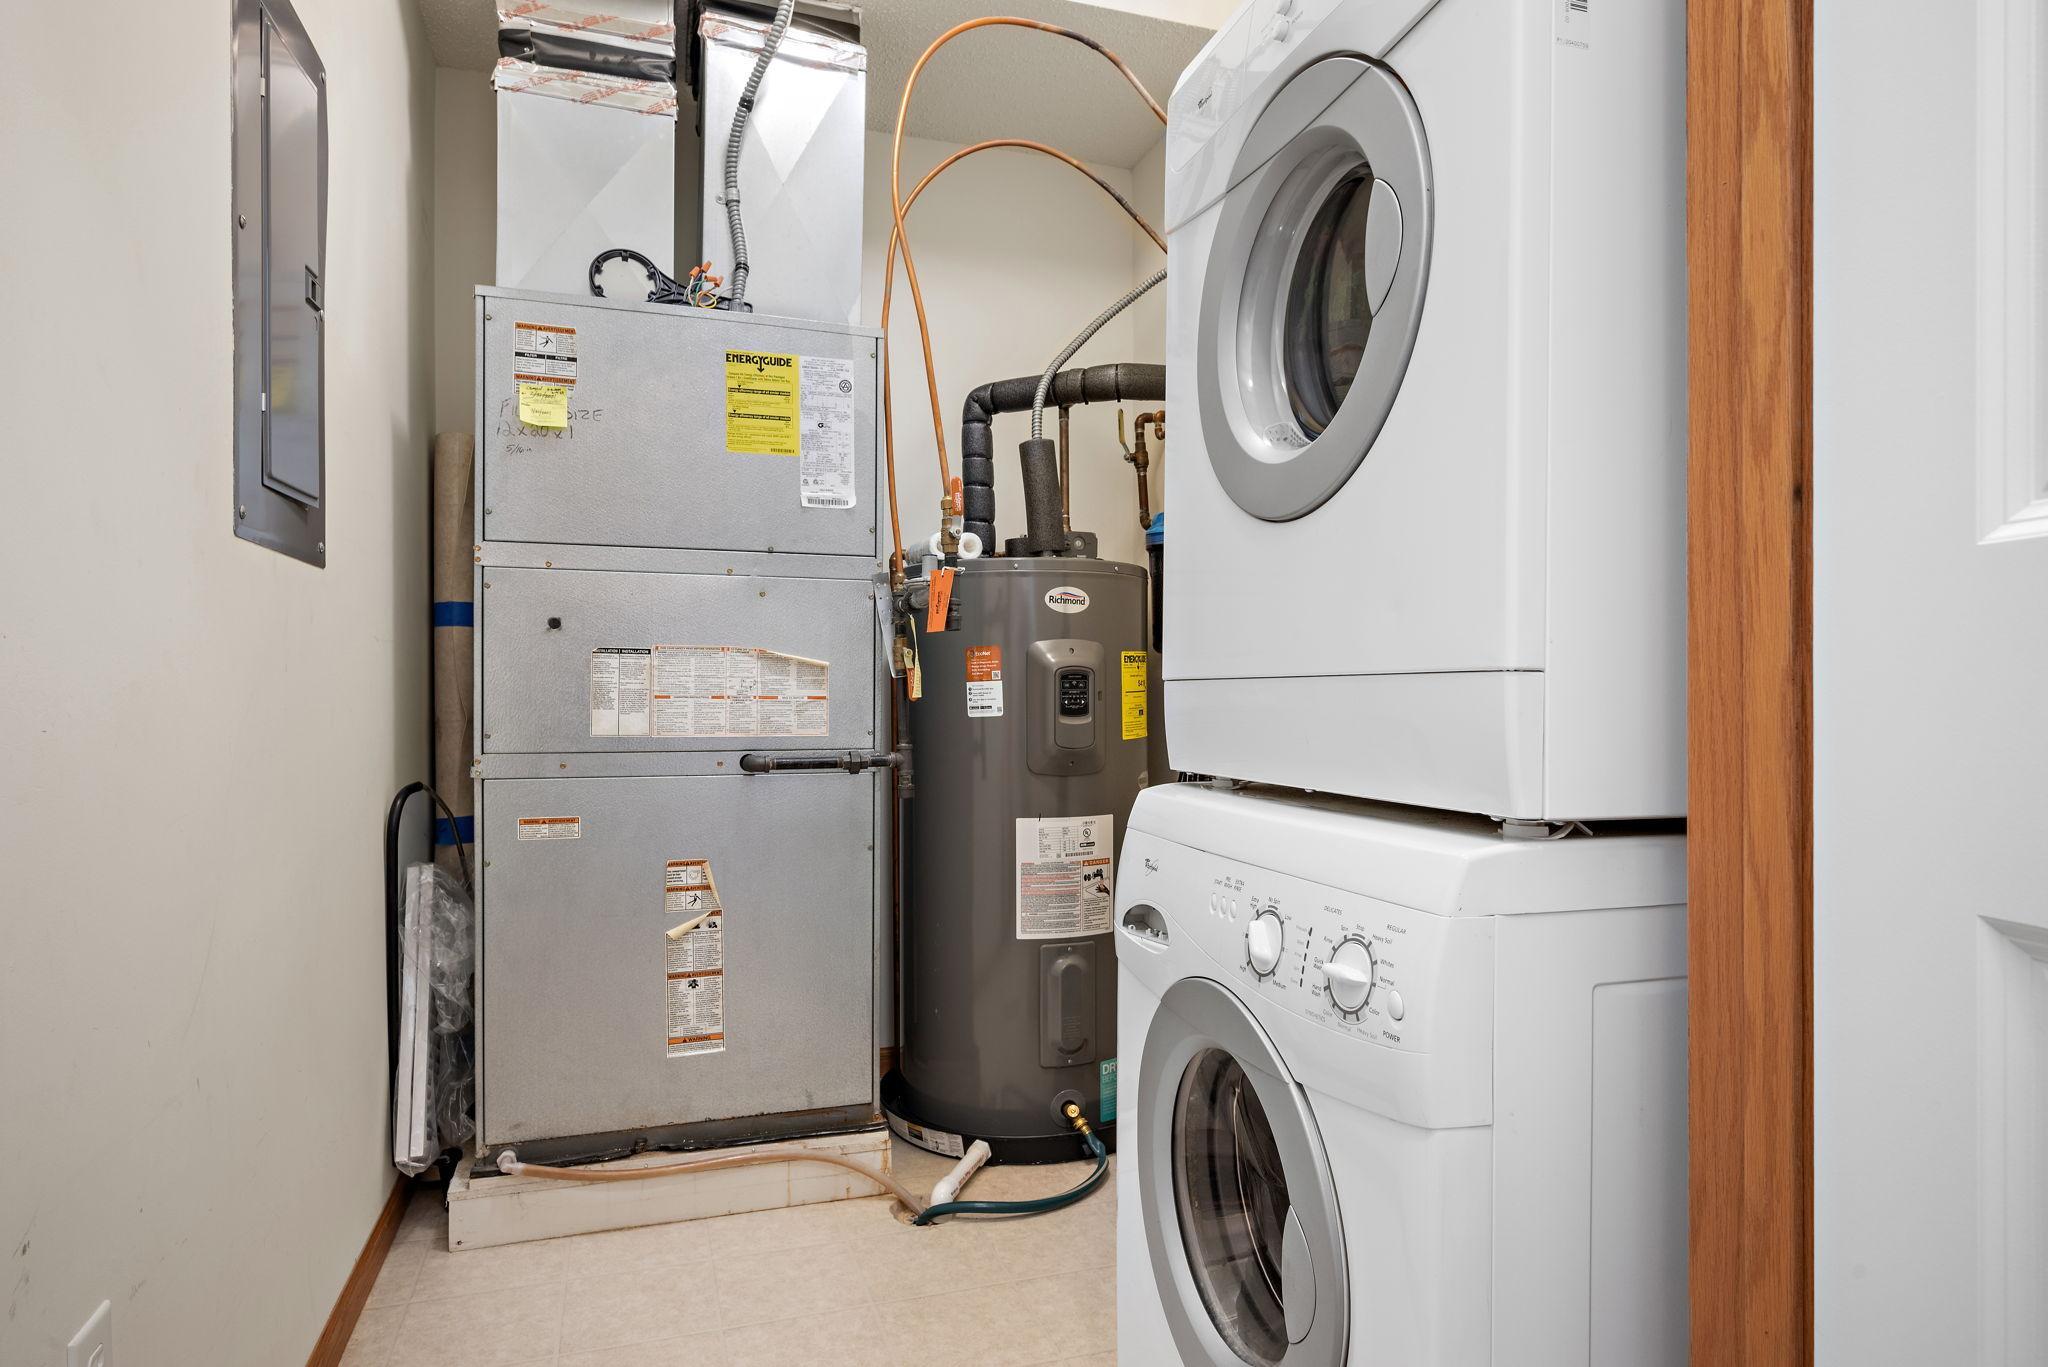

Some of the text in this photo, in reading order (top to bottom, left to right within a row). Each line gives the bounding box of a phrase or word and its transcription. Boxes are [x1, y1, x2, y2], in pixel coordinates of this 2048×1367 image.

[726, 353, 793, 368] ENERGYGUIDE
[1048, 595, 1086, 606] Richmond
[1387, 924, 1406, 935] REGULAR
[1379, 977, 1395, 987] Normal
[1383, 1030, 1401, 1043] POWER
